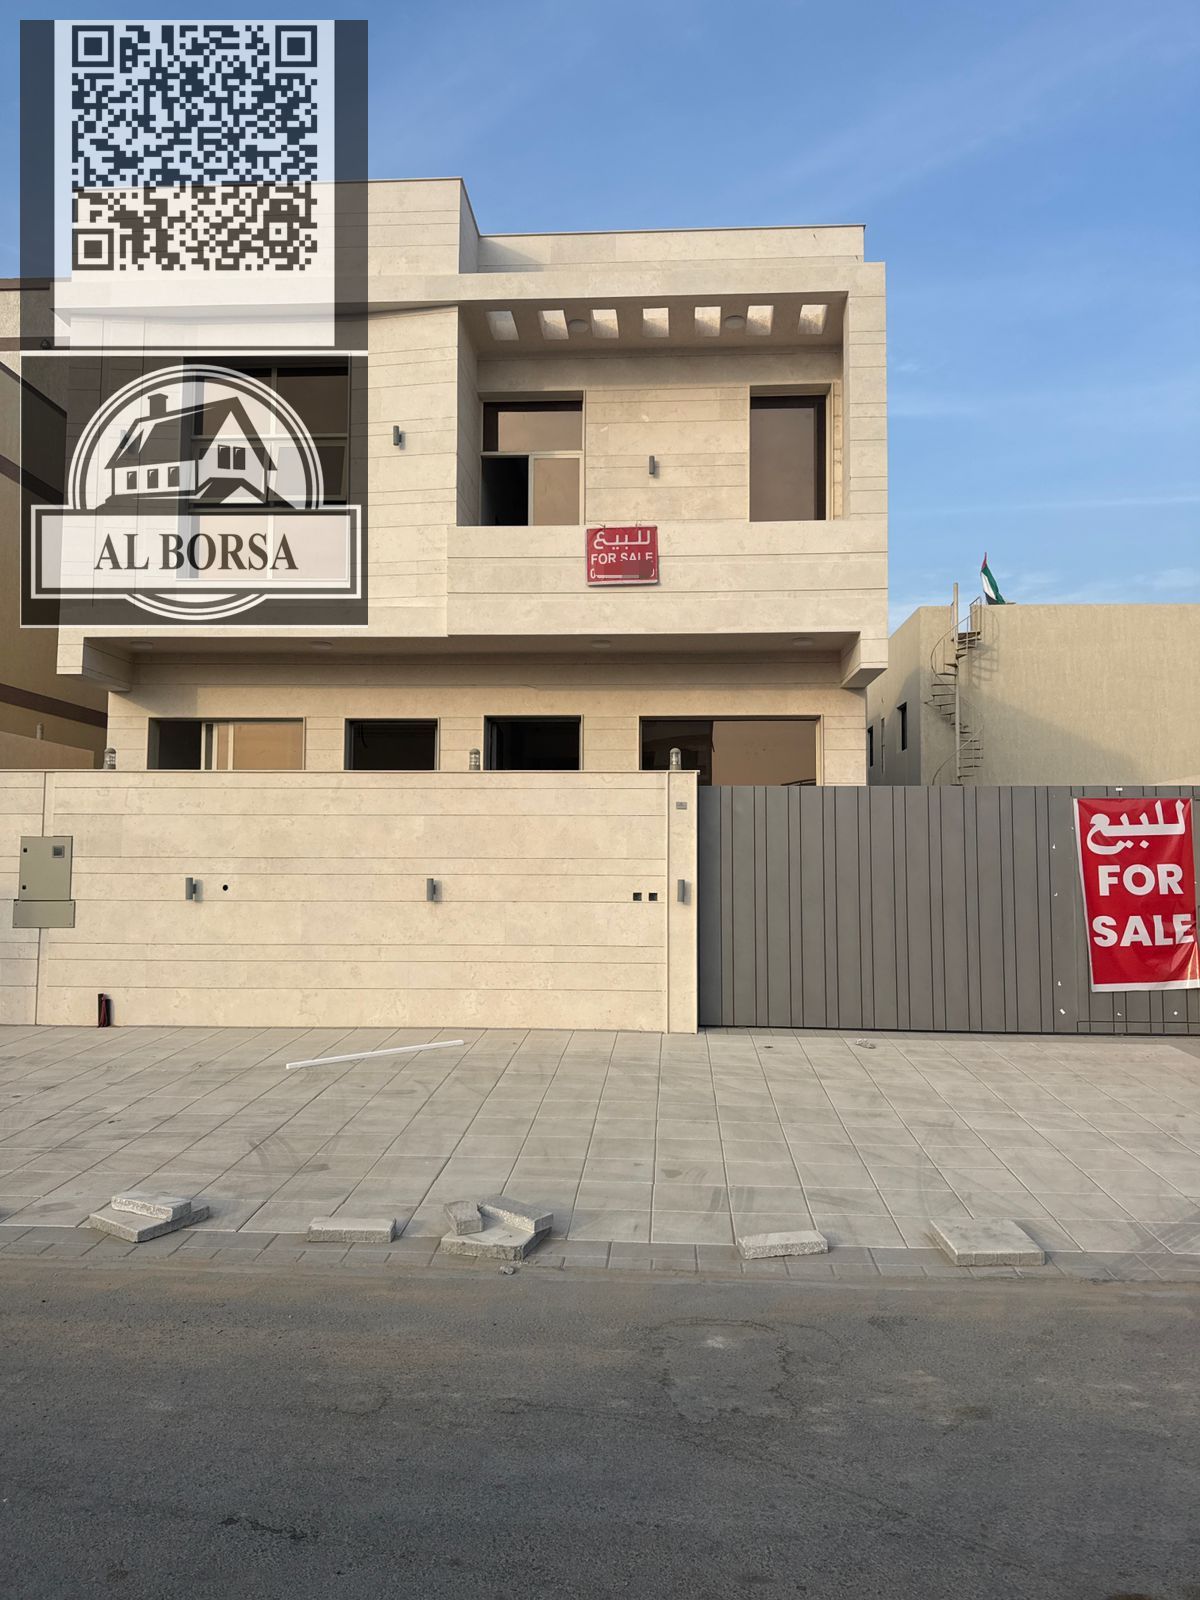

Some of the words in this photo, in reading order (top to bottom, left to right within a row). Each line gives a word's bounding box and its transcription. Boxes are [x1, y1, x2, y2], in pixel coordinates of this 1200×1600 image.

[594, 530, 650, 549] للبيع
[591, 552, 616, 565] FOR
[1087, 800, 1185, 855] للبيع
[1098, 864, 1184, 896] FOR
[1092, 914, 1194, 947] SALE
